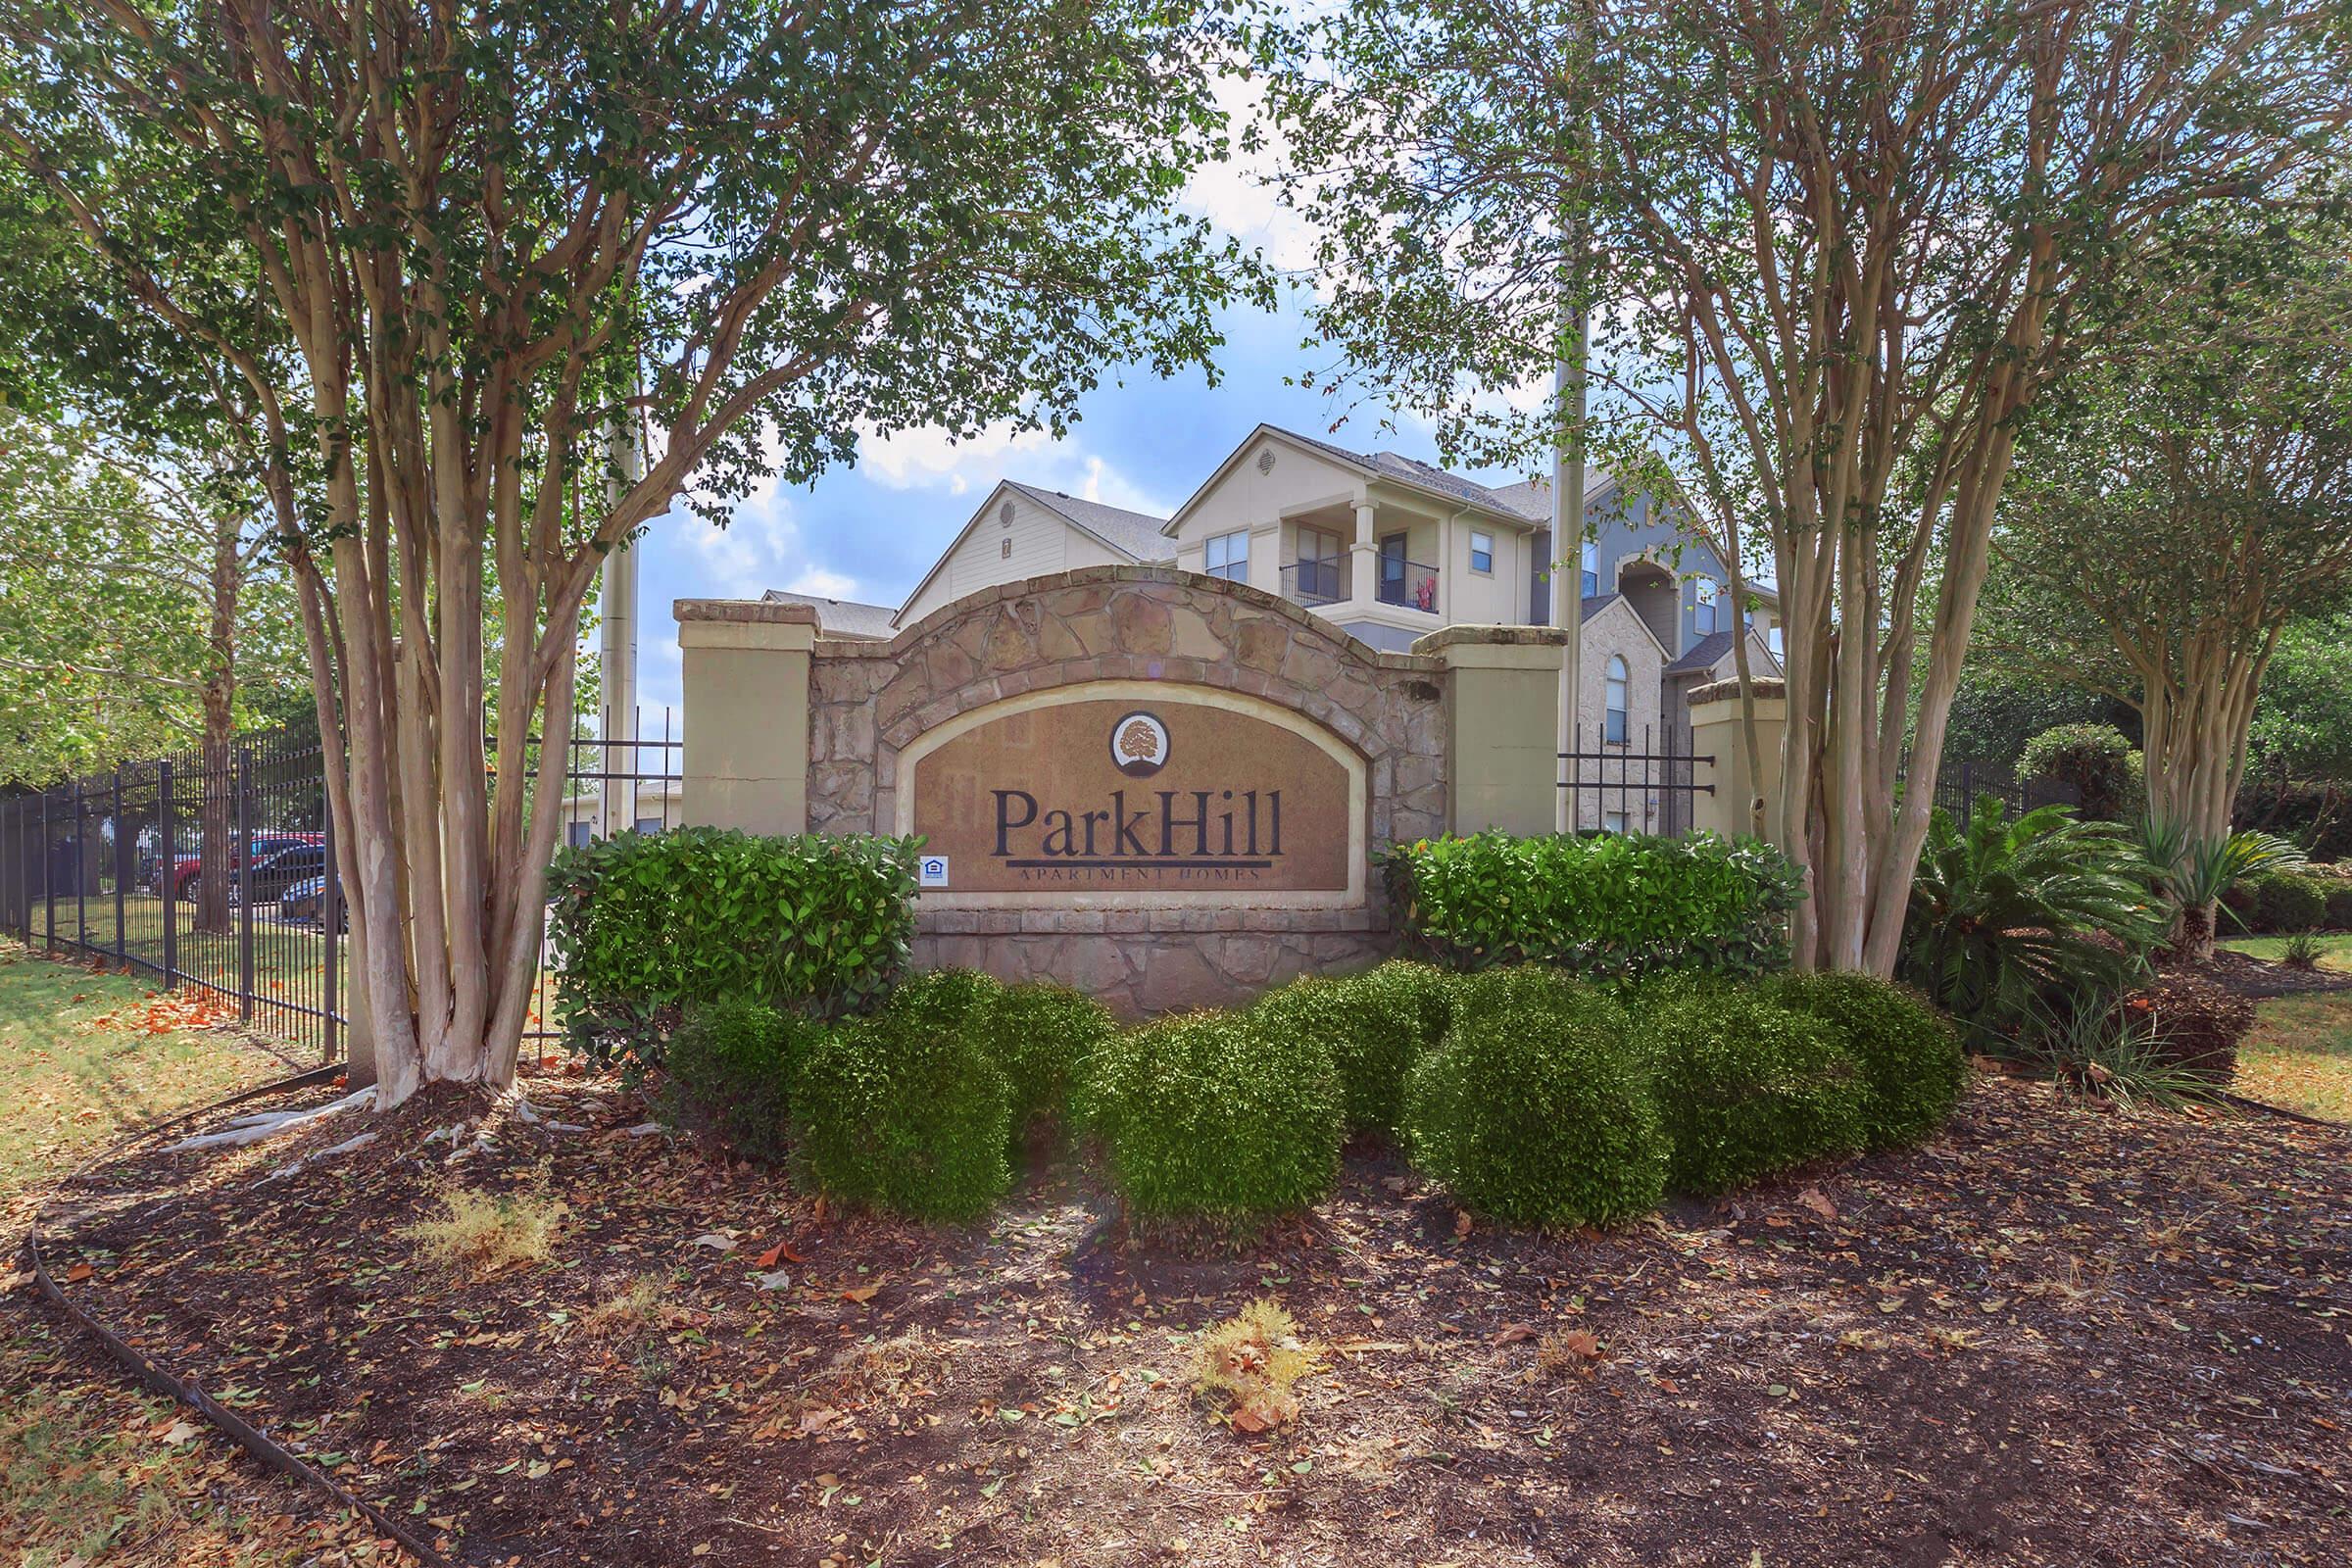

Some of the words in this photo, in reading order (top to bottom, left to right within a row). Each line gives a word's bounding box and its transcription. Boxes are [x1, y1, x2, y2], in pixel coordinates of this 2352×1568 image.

[989, 789, 1286, 857] ParkHill
[1019, 868, 1163, 881] APARTMENT
[1179, 868, 1259, 881] HOMES
